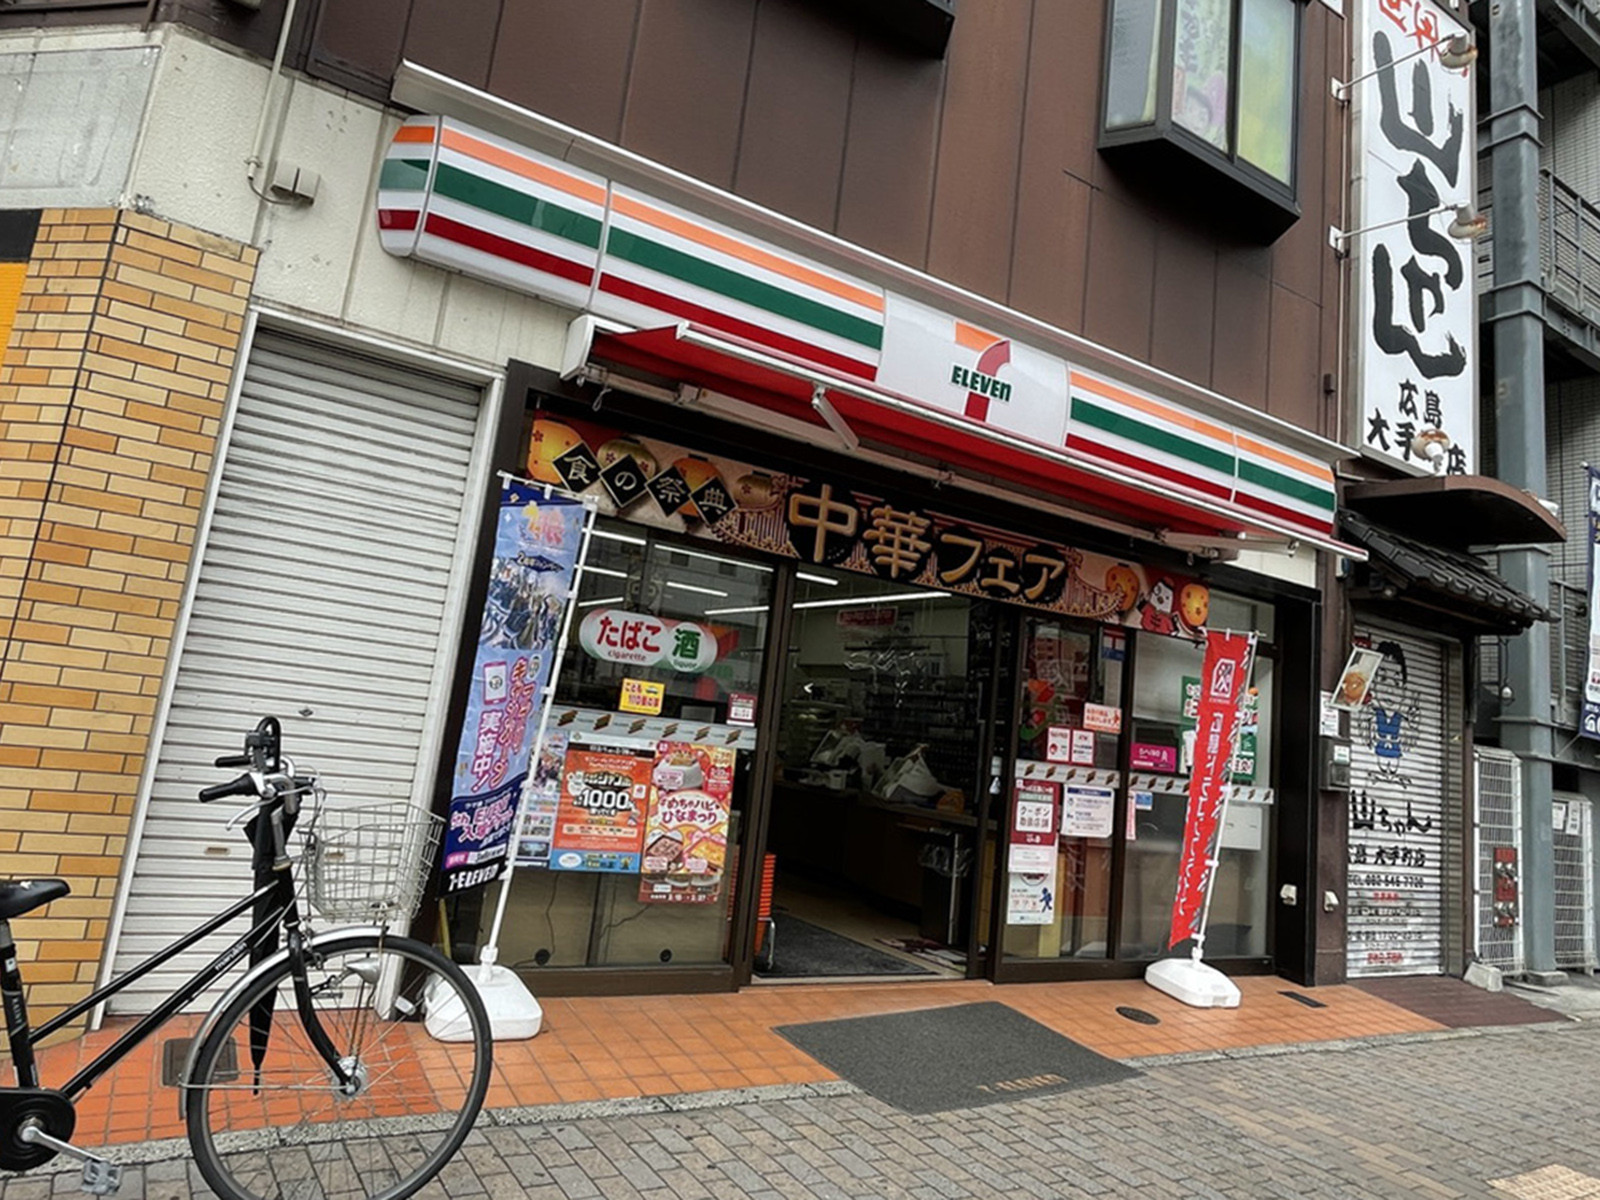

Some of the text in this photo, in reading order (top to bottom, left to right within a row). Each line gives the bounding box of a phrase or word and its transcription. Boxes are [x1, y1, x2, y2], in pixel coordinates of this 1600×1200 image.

[1399, 378, 1443, 430] 広島
[1367, 407, 1467, 475] 大手店
[563, 454, 728, 516] 食の祭典
[789, 483, 1066, 601] 中華フェア
[597, 616, 661, 653] たばこ
[672, 628, 701, 660] 酒
[581, 788, 630, 811] 1000
[661, 810, 719, 826] ひなまつり
[1351, 789, 1432, 837] 山ちゃん
